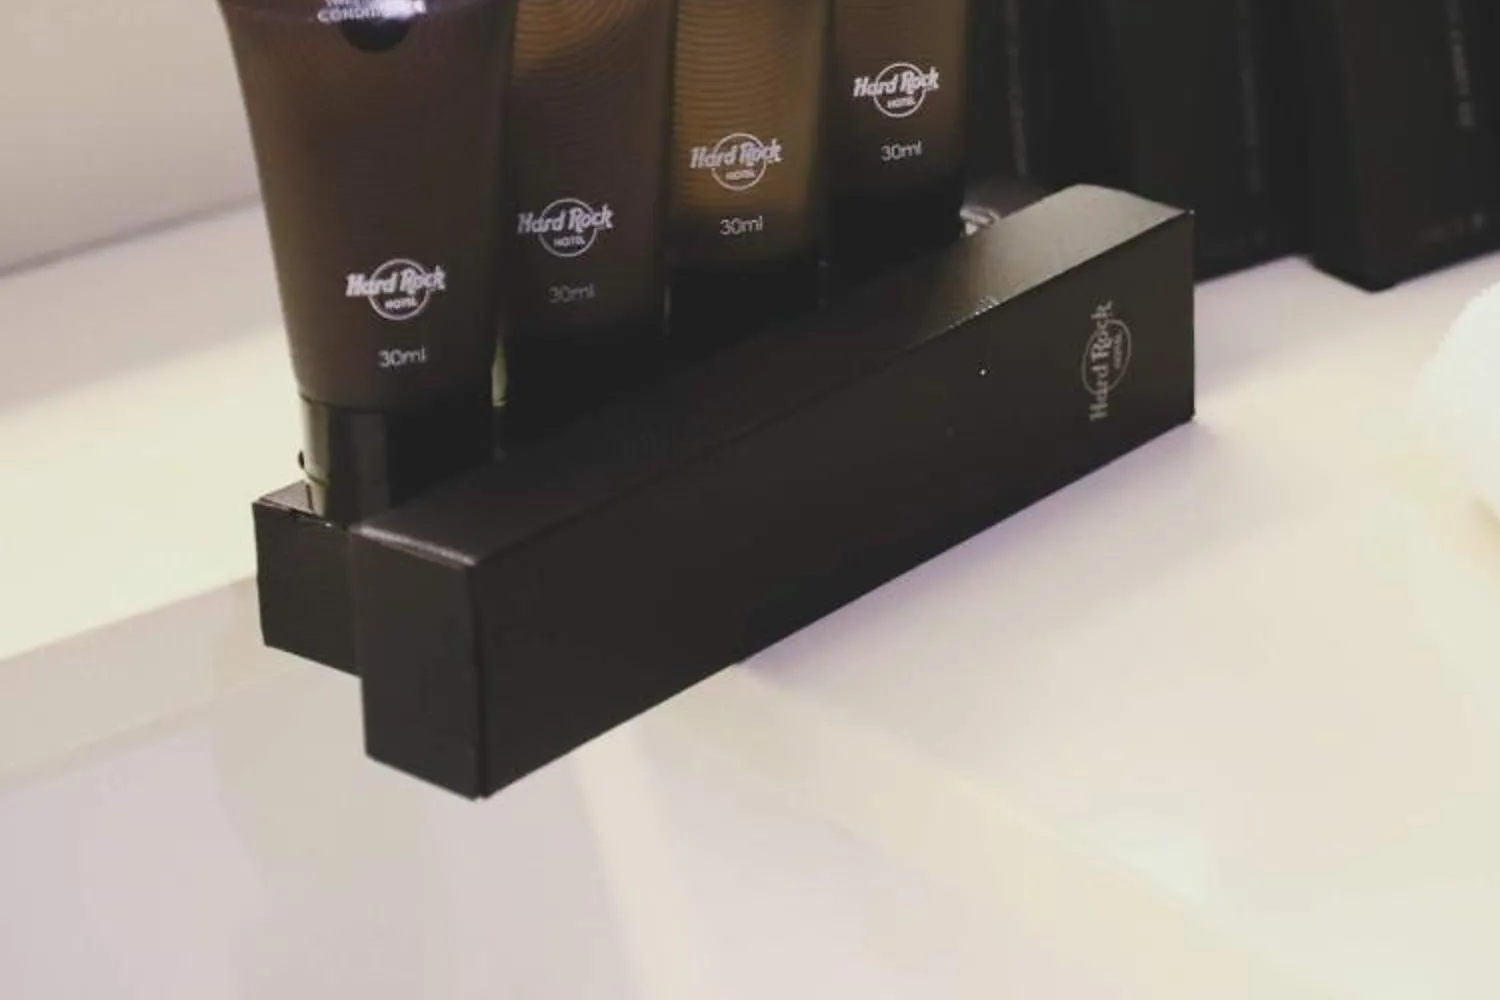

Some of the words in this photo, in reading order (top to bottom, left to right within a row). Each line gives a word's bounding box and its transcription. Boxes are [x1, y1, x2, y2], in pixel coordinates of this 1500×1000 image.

[853, 73, 899, 97] Hard
[899, 66, 940, 95] Rock
[690, 144, 739, 169] Hard
[739, 138, 783, 167] Rock
[880, 140, 924, 162] 30ml
[517, 209, 567, 234] Hard
[567, 202, 615, 234] Rock
[719, 215, 764, 236] 30ml
[345, 271, 399, 297] Hard
[399, 264, 447, 296] Rock
[547, 283, 596, 304] 30ml
[1090, 300, 1113, 362] Rock
[377, 345, 428, 368] 30ml
[1088, 363, 1110, 422] Hard
